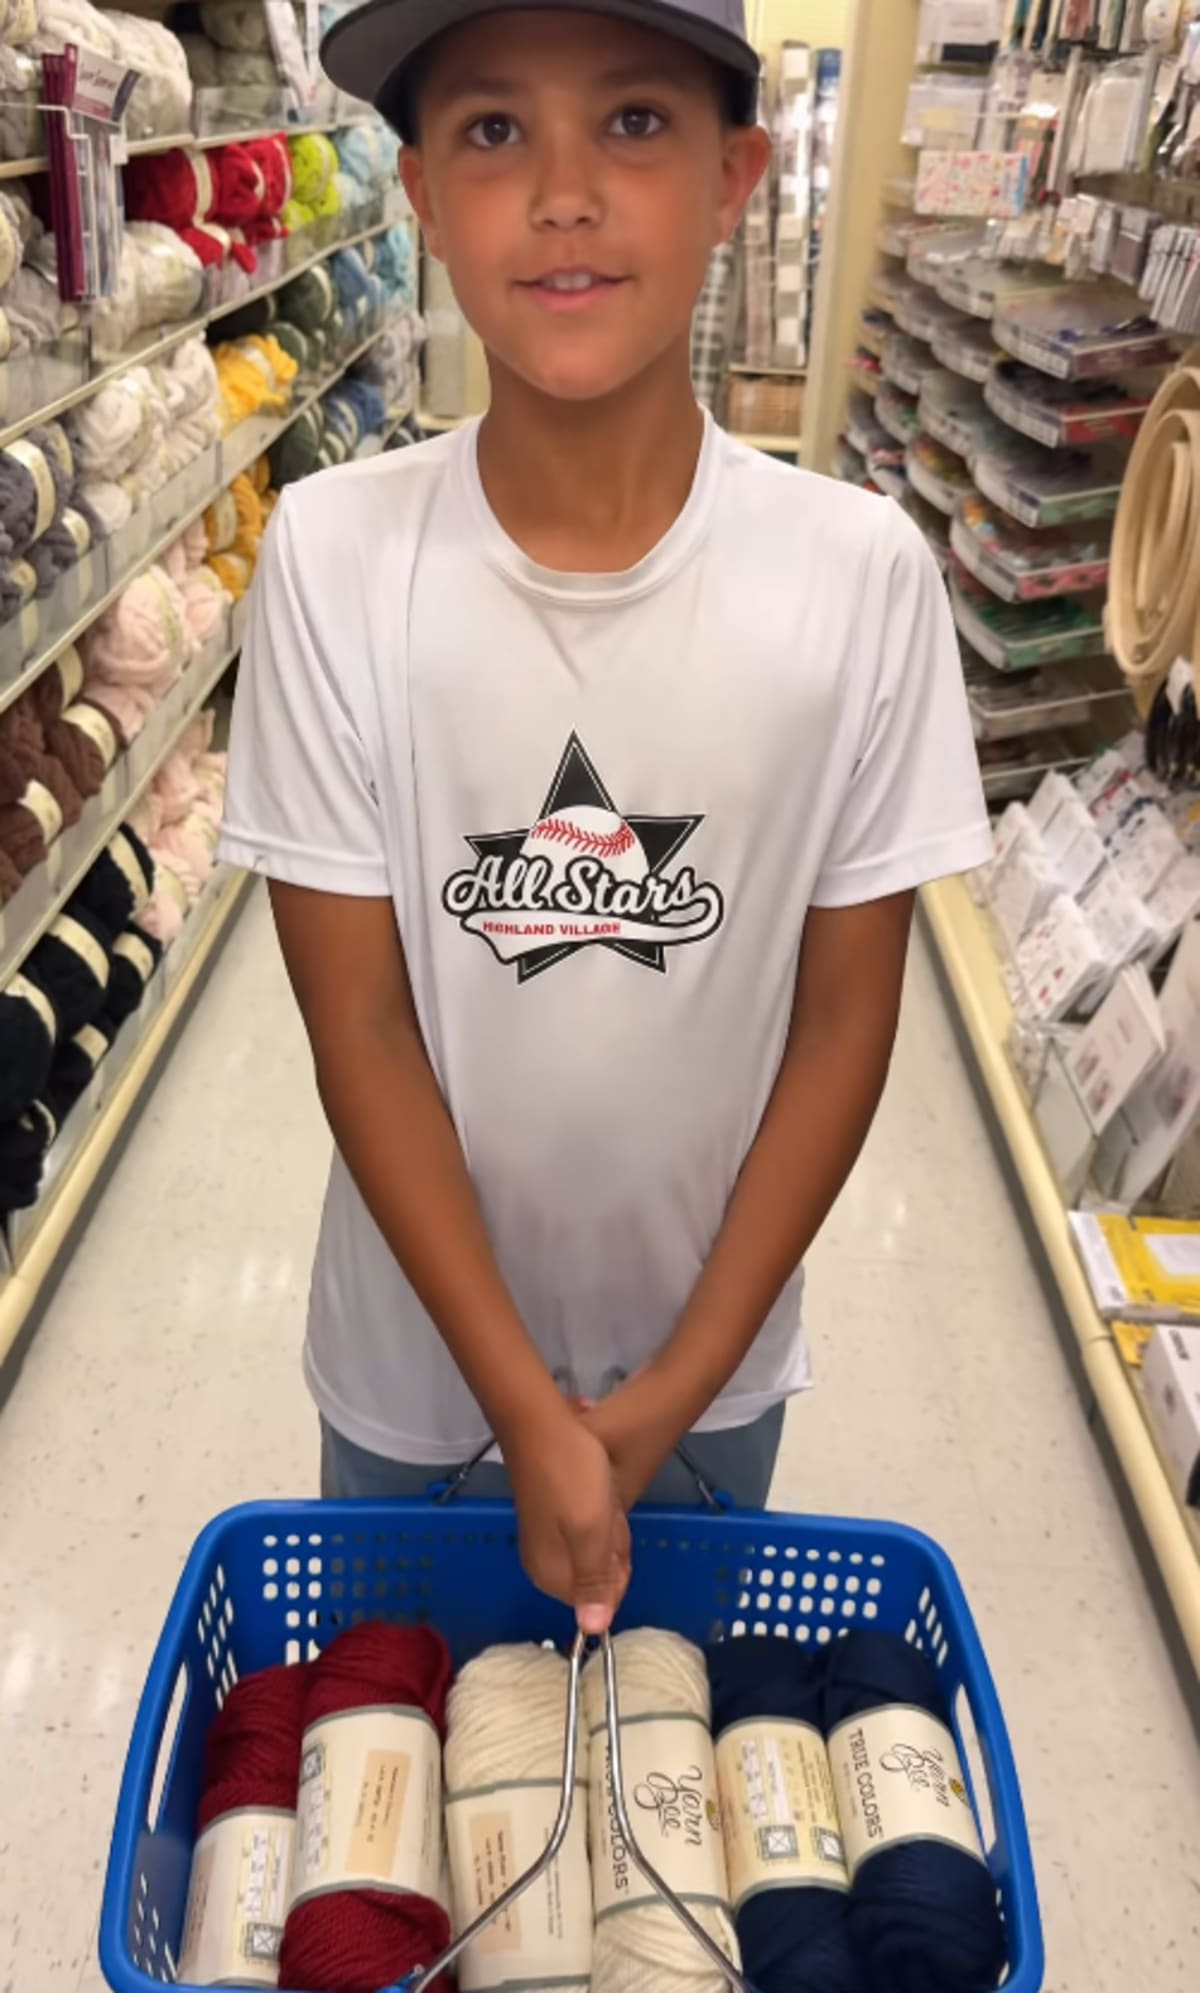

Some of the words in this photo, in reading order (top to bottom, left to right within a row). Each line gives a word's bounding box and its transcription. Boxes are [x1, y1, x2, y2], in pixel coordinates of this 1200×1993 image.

[442, 854, 552, 914] All
[551, 856, 698, 916] Stars
[483, 921, 554, 935] HIGHLAND
[560, 922, 621, 935] VILLAGE
[849, 1728, 870, 1770] TRUE
[879, 1743, 930, 1791] Bee
[920, 1745, 950, 1807] Yarn
[634, 1772, 682, 1833] Bee
[677, 1765, 703, 1846] Yarn
[857, 1772, 884, 1838] COLORS
